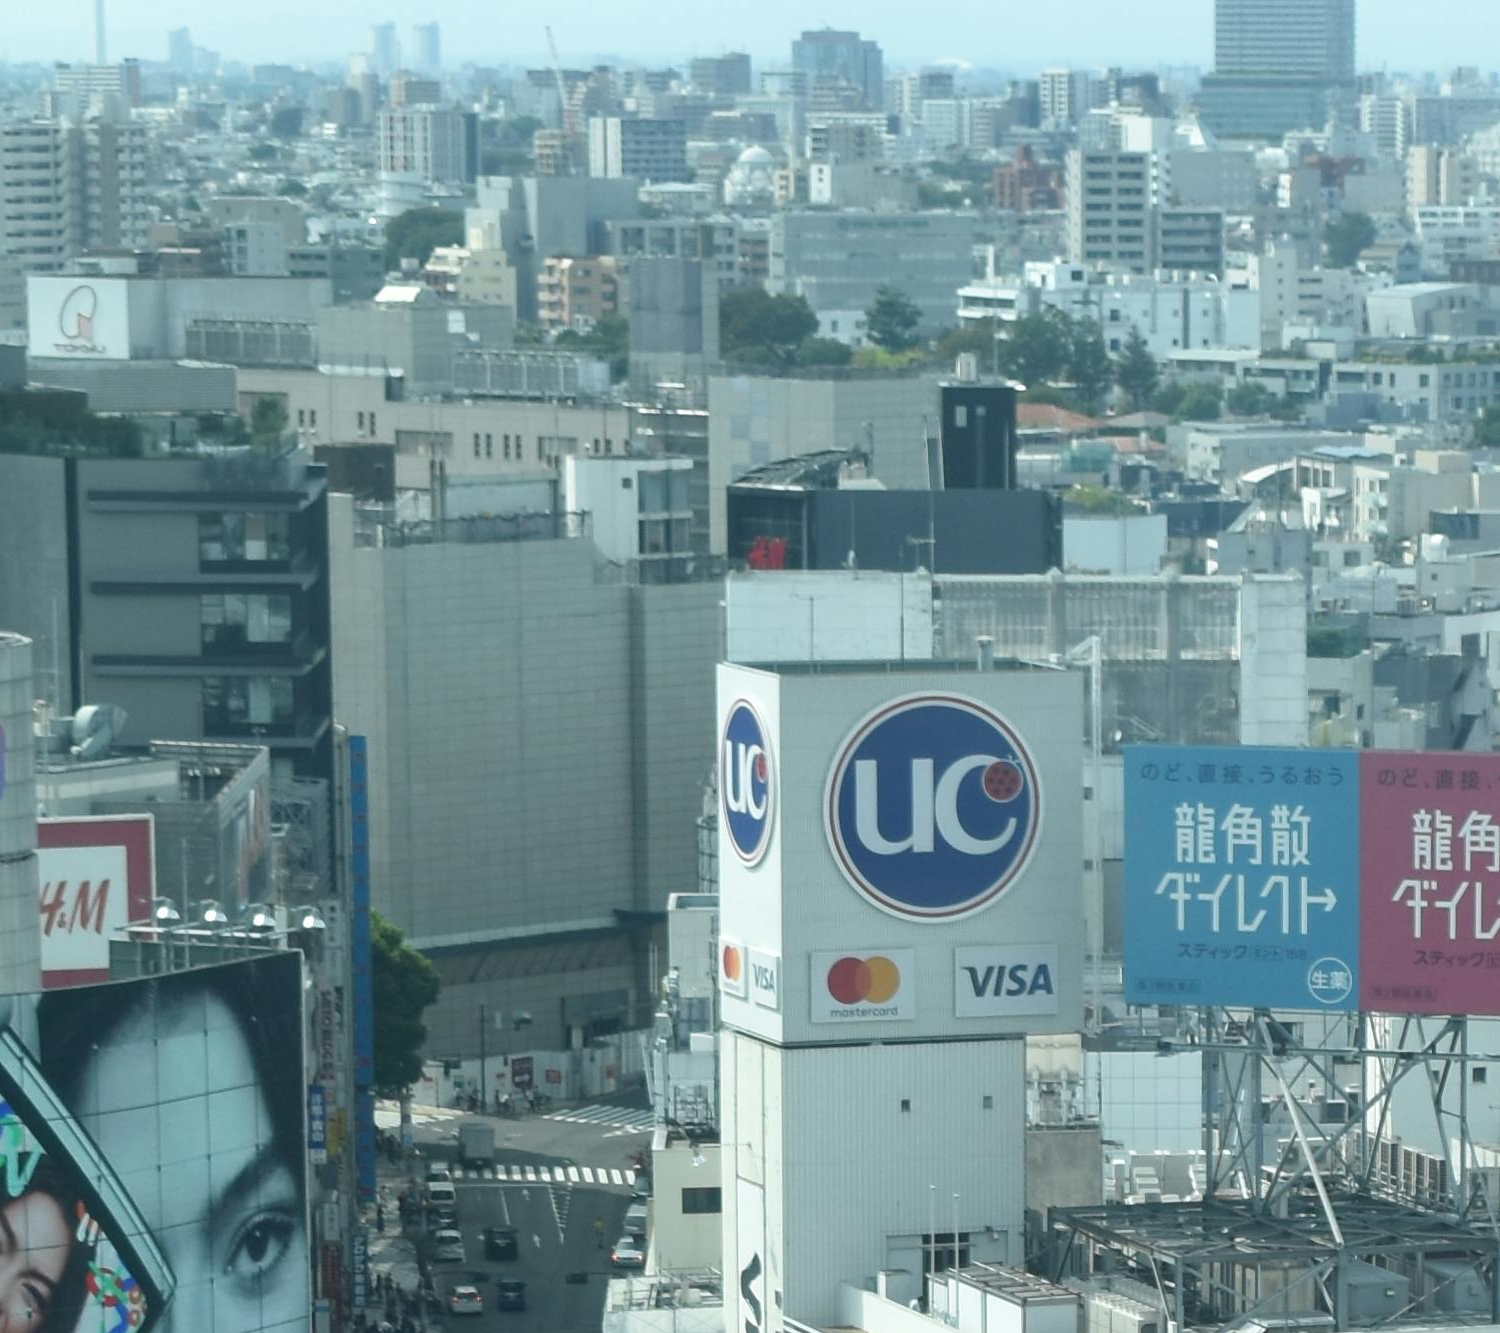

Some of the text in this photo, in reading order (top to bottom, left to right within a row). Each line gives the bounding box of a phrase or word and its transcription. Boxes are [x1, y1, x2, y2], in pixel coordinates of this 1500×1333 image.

[1136, 760, 1346, 790] のど、直接、うるおう
[1170, 801, 1314, 868] 龍角散
[1153, 870, 1340, 938] ダイレクト
[749, 961, 778, 995] VISA
[960, 962, 1056, 1000] VISA
[1309, 969, 1349, 993] 生薬
[827, 1004, 901, 1020] mastercard
